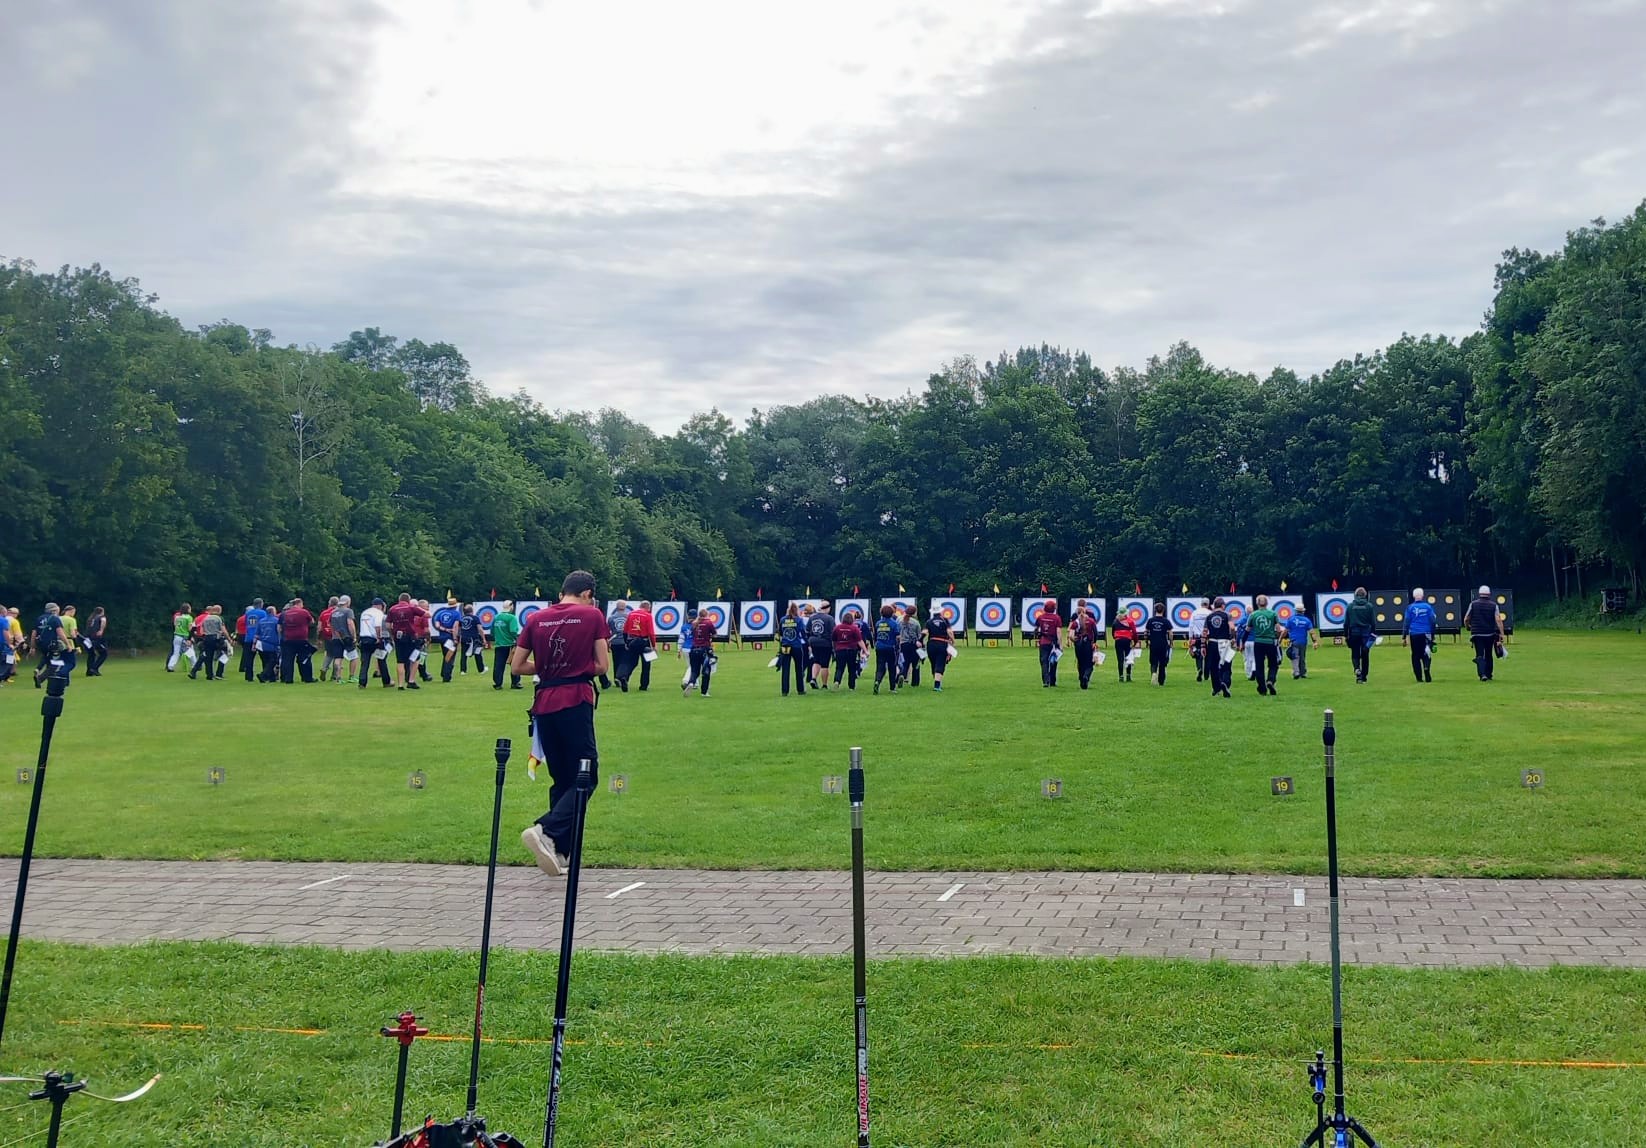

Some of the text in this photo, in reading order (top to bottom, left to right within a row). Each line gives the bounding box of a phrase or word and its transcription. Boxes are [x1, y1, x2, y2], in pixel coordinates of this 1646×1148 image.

[412, 776, 422, 785] 15
[614, 779, 624, 789] 16
[1526, 774, 1541, 785] 20
[1047, 783, 1057, 793] 18
[1276, 781, 1289, 791] 19
[858, 1048, 868, 1075] PRO
